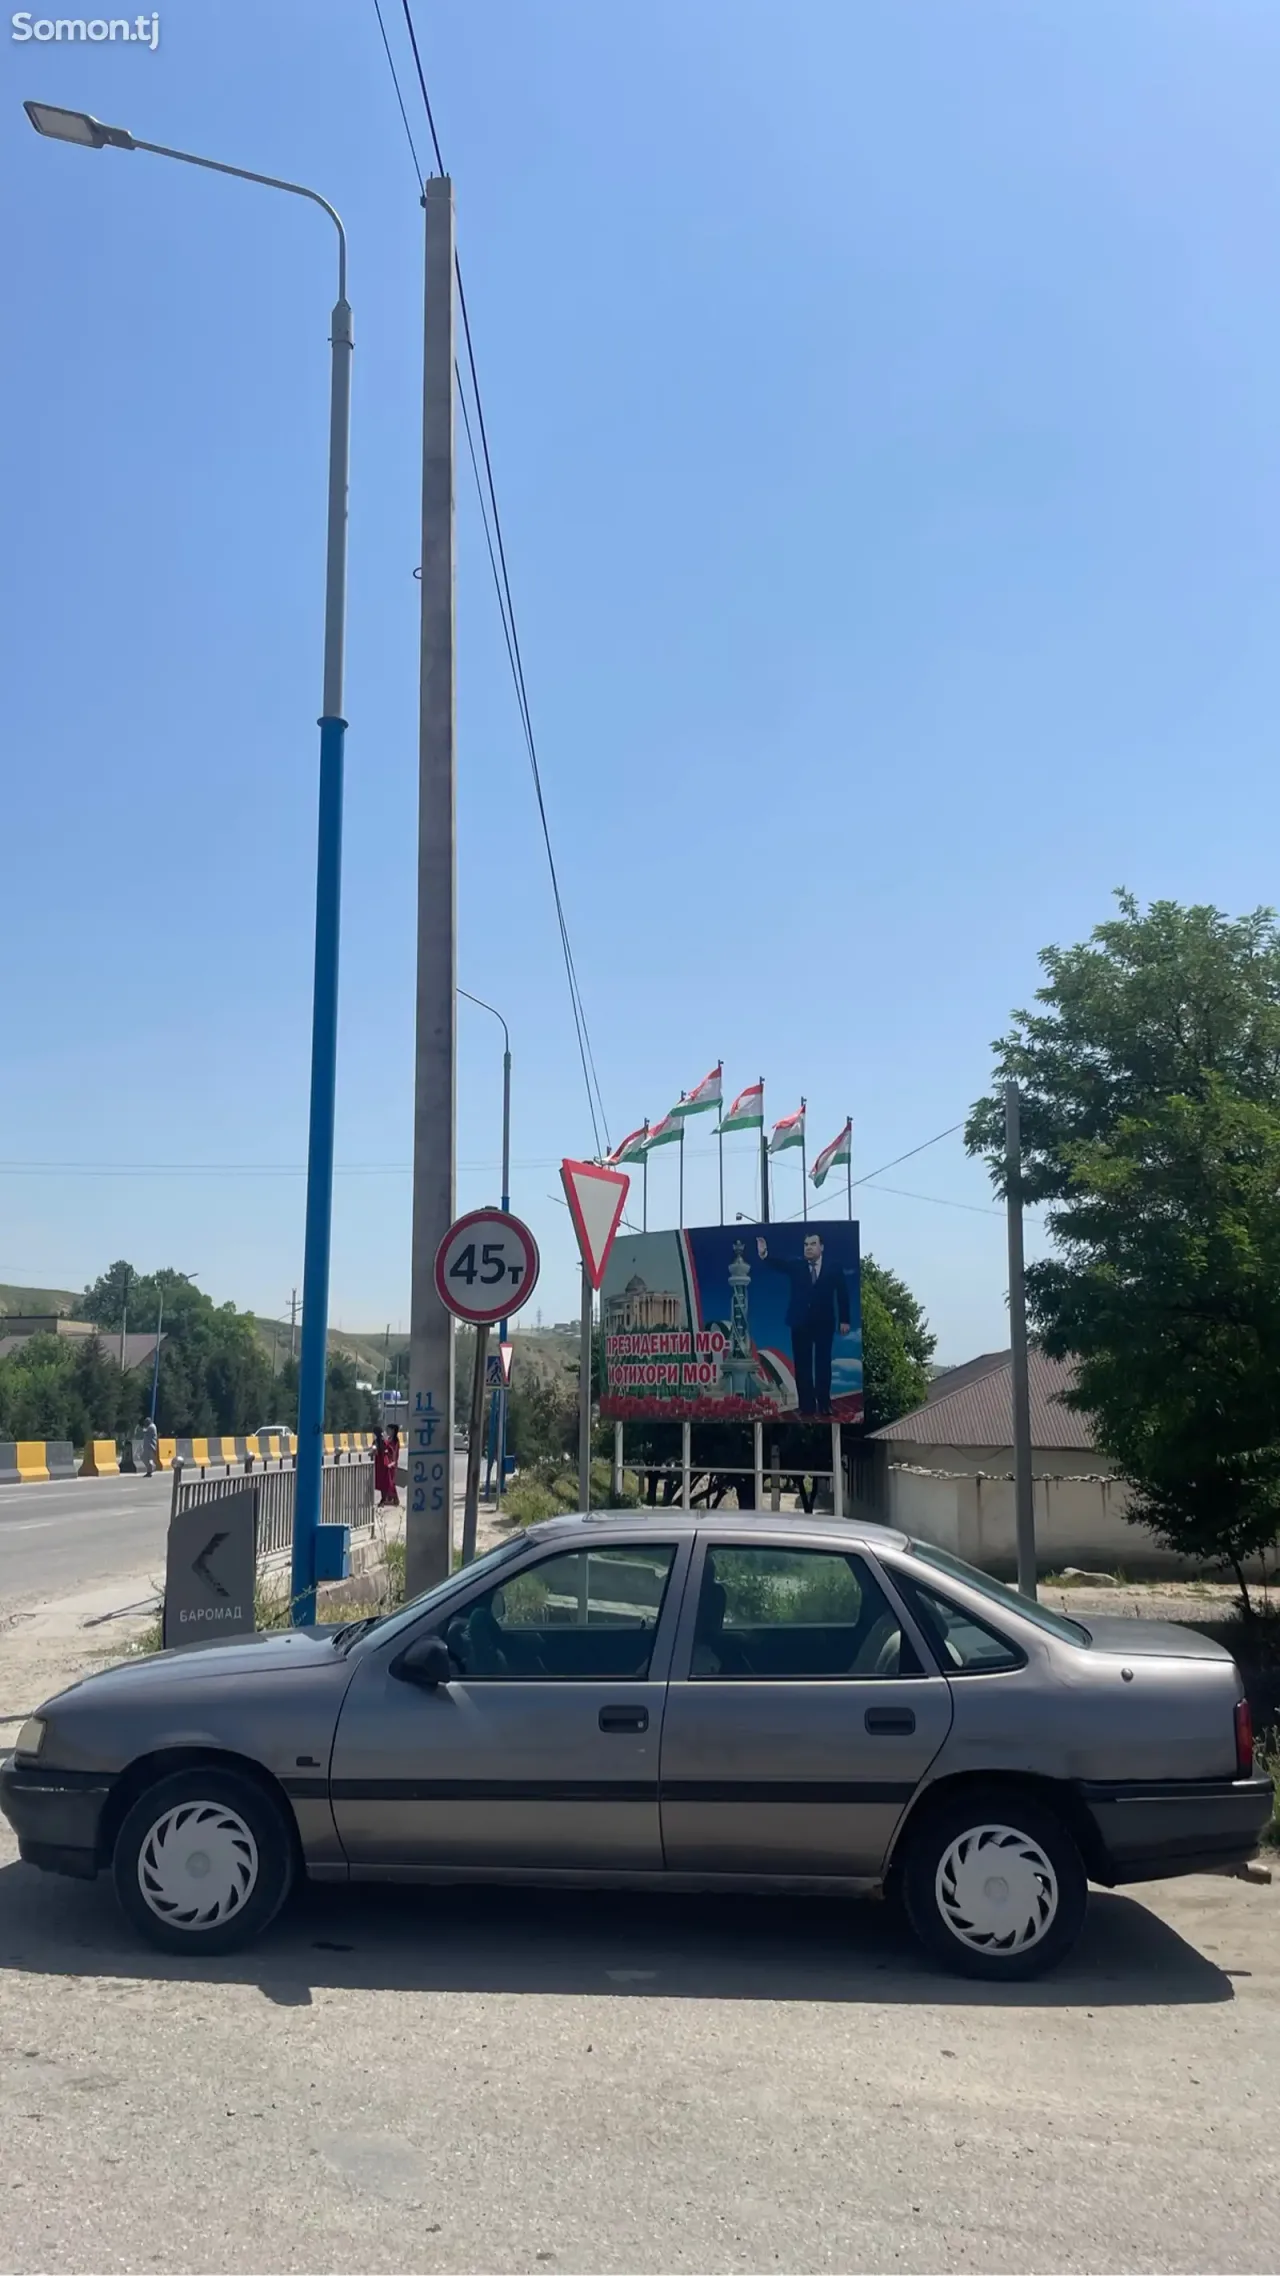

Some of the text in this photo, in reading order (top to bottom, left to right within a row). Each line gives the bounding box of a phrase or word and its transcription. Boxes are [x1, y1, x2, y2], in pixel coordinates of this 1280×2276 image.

[607, 1333, 691, 1356] ПРЕЗИДЕНТИ
[608, 1364, 717, 1385] ИФТИХОРИ МО!
[412, 1488, 443, 1512] 25
[179, 1605, 242, 1622] БАРОМАД
